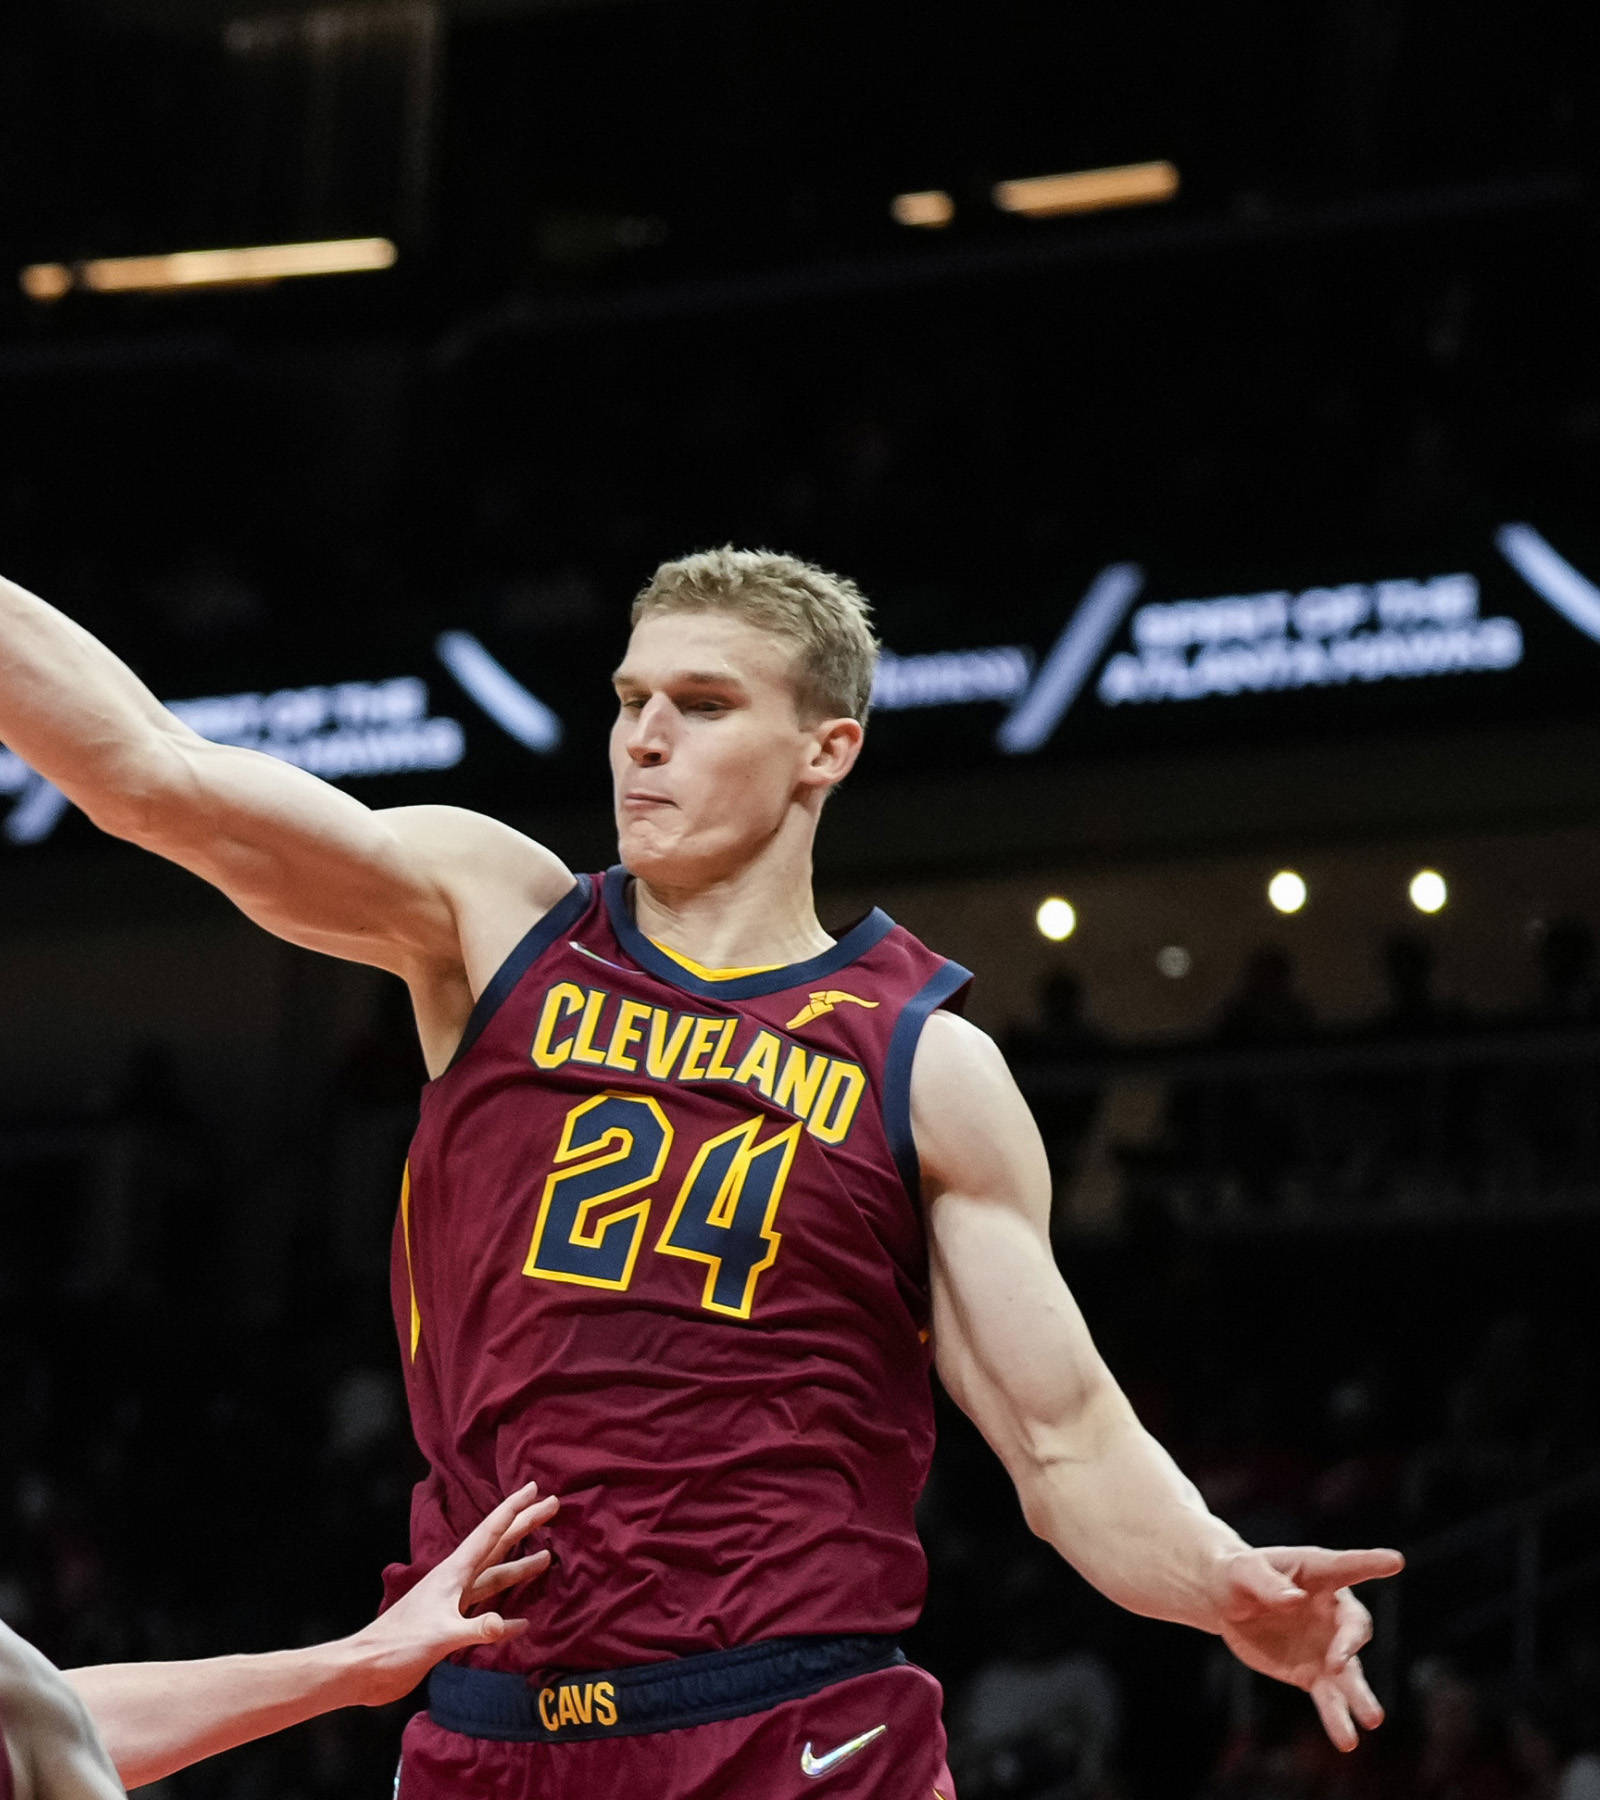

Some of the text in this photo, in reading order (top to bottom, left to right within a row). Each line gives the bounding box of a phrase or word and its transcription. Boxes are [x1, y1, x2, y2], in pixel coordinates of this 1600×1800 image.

[530, 981, 867, 1146] CLEVELAND
[522, 1089, 802, 1320] 24
[538, 1681, 618, 1732] CAVS
